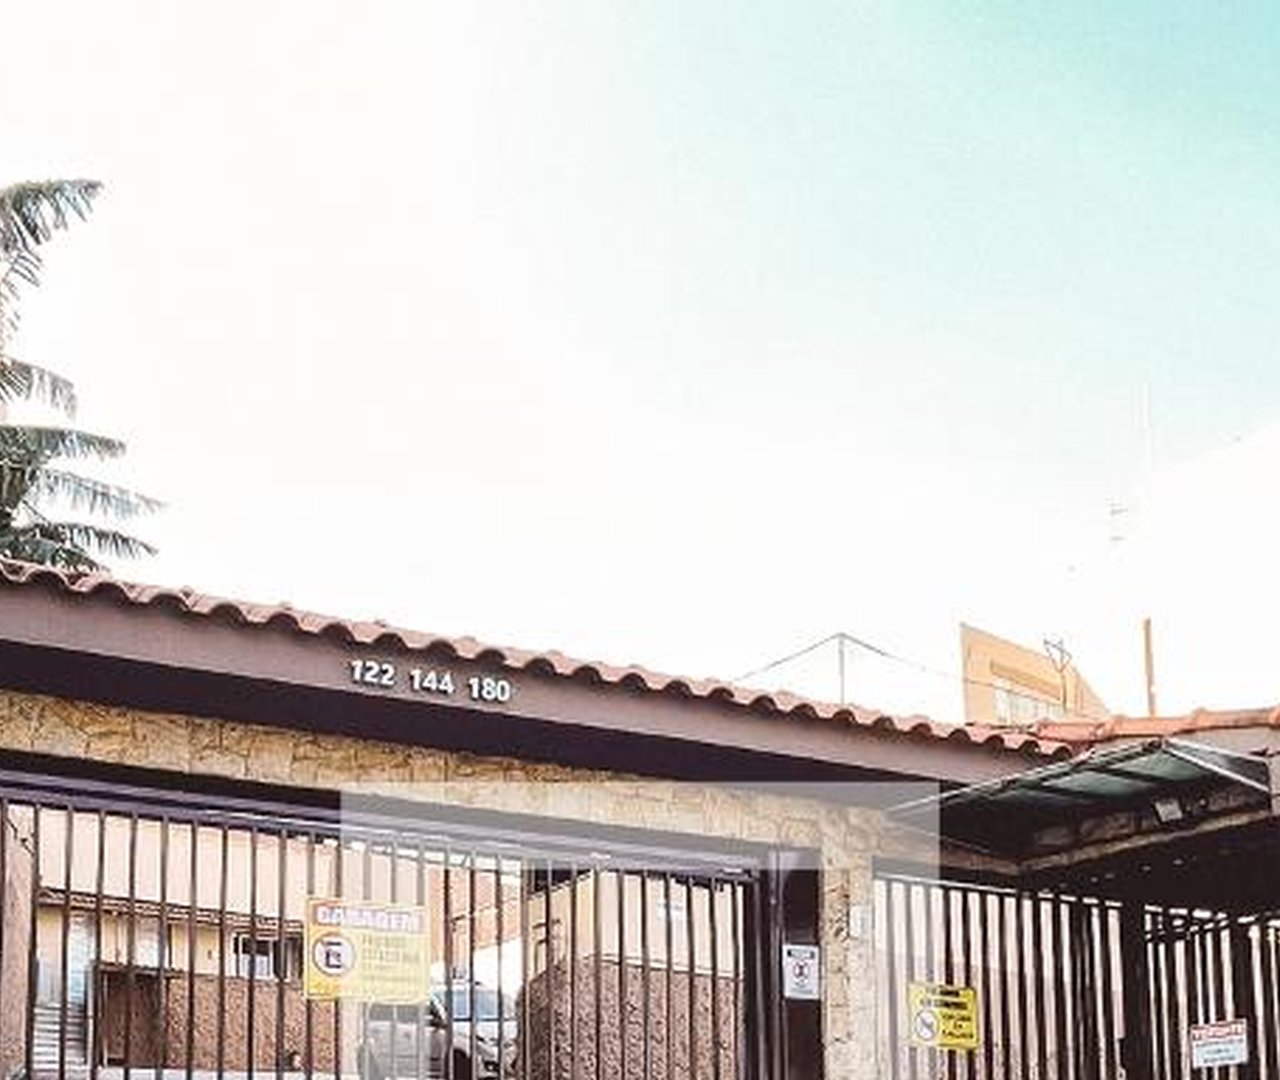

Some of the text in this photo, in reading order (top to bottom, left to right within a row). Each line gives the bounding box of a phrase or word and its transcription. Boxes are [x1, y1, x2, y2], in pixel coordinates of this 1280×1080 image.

[350, 659, 512, 702] 122 144 180
